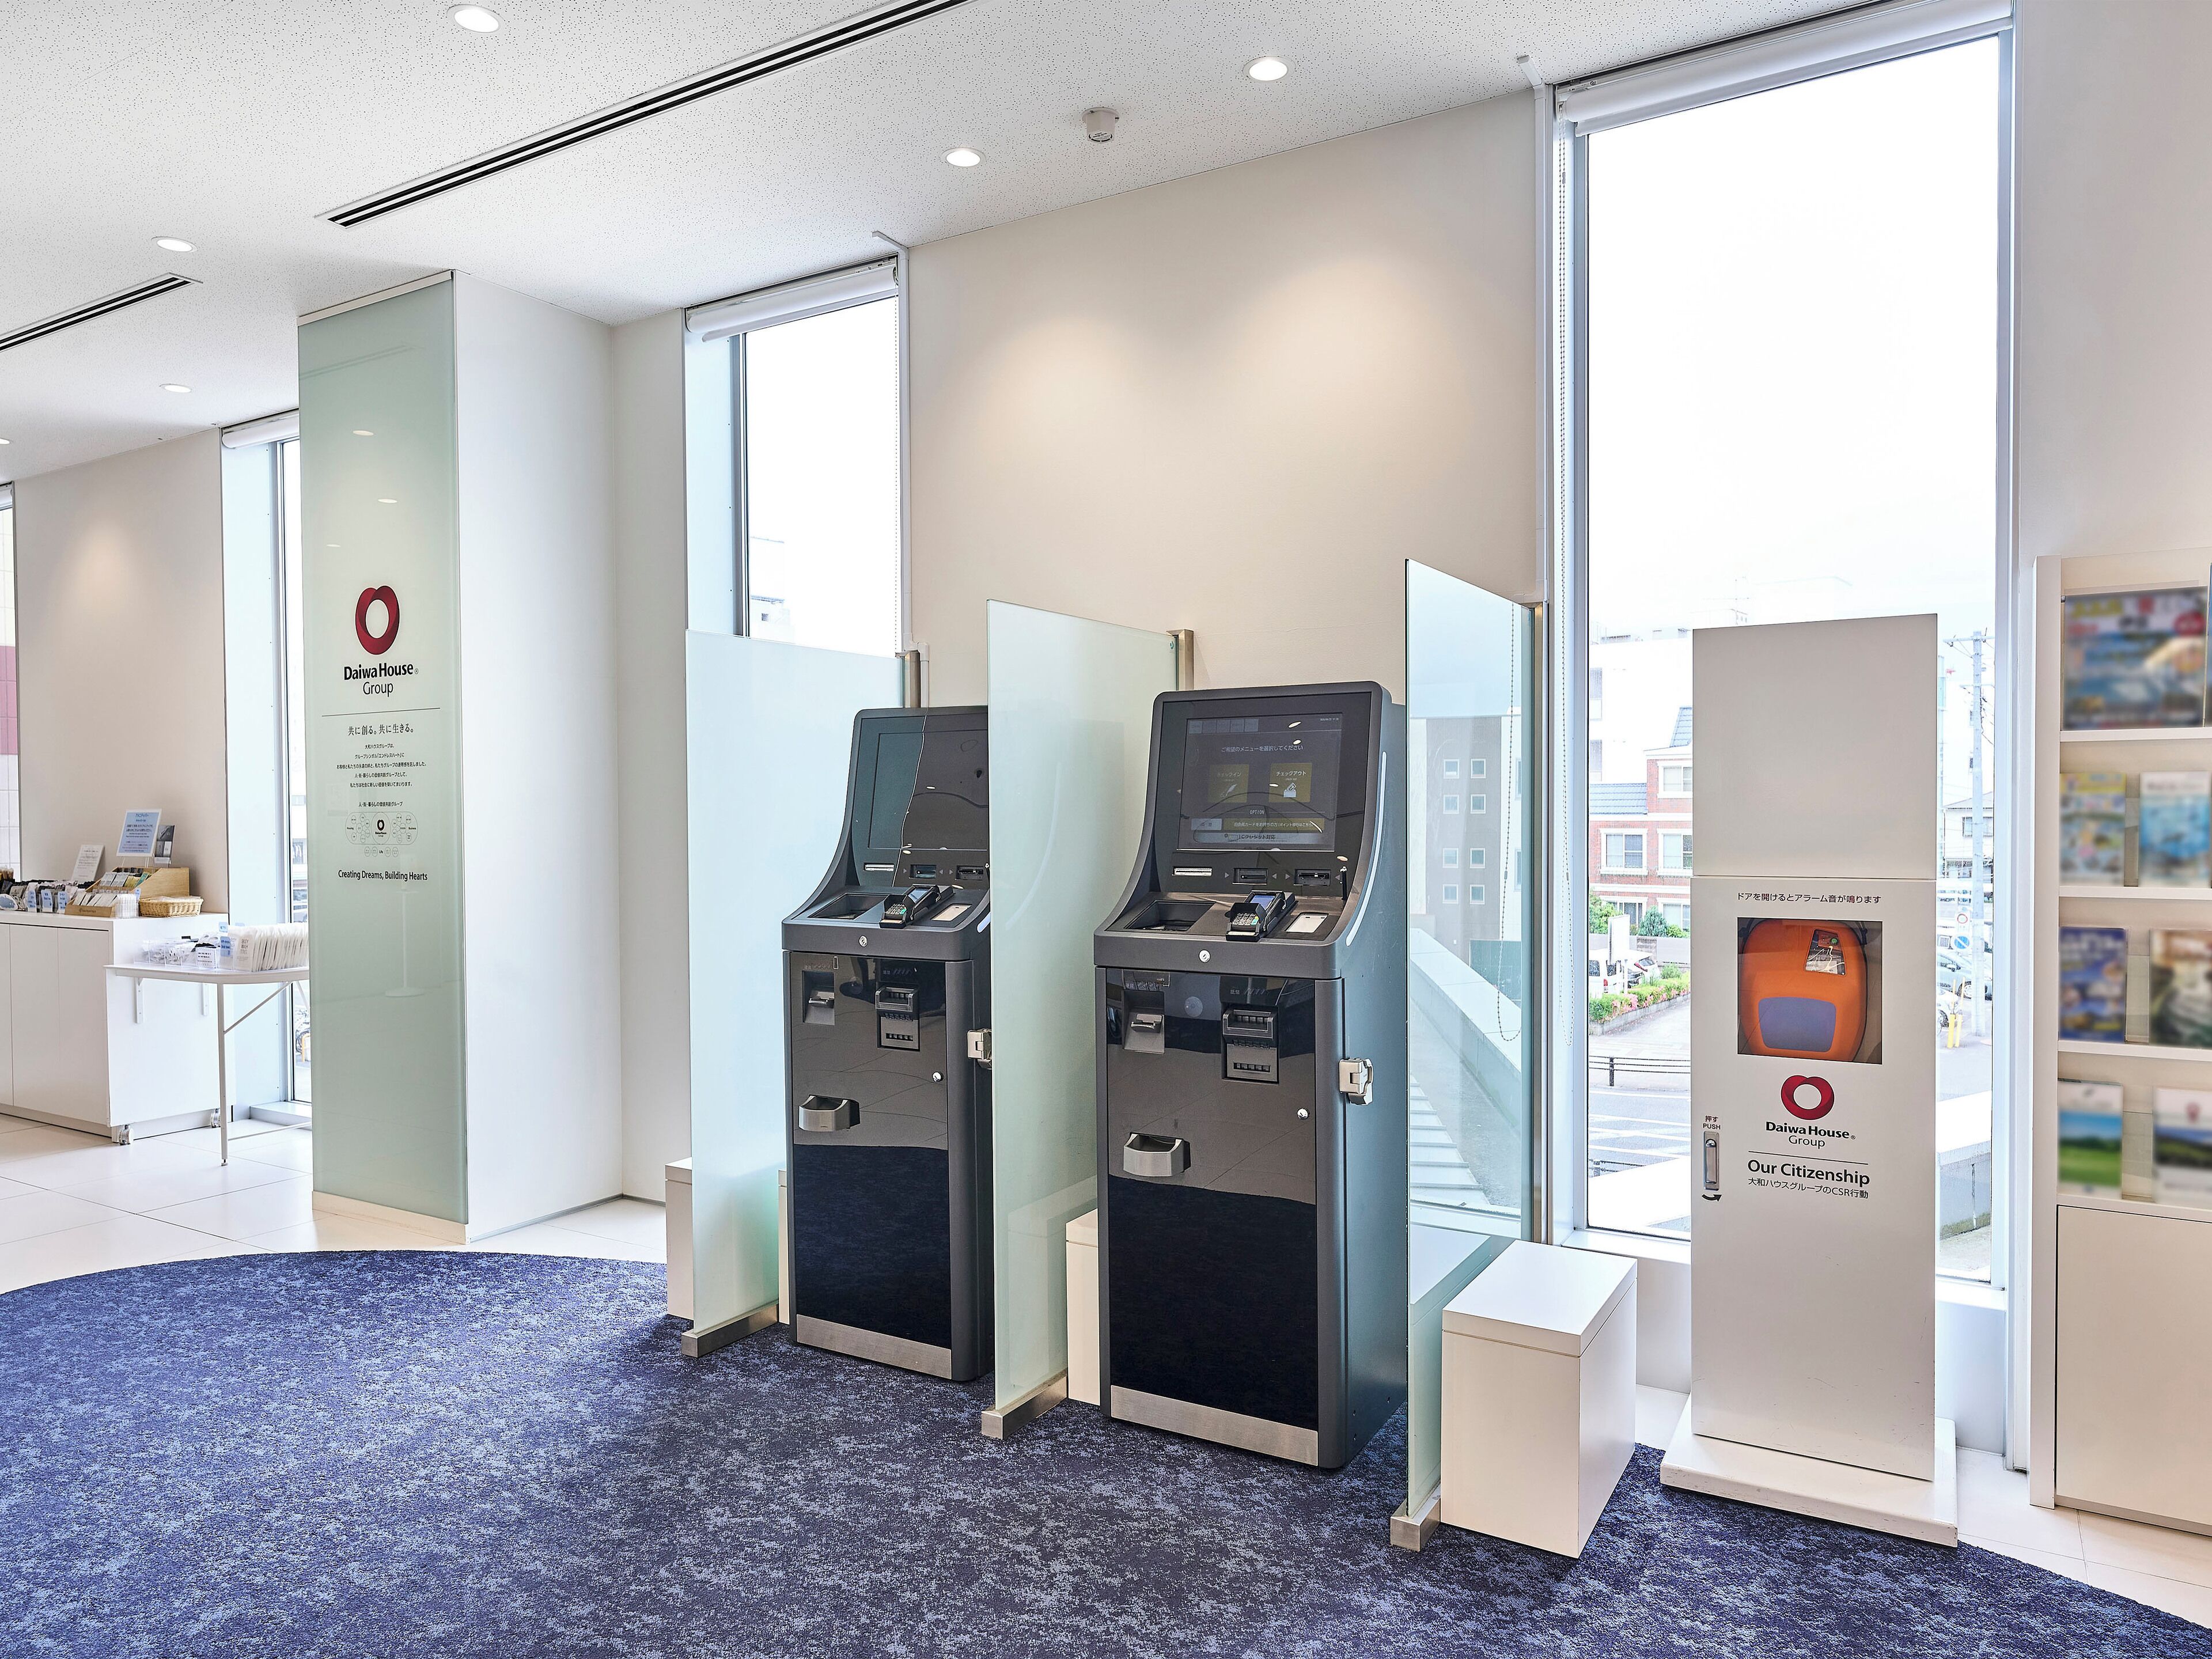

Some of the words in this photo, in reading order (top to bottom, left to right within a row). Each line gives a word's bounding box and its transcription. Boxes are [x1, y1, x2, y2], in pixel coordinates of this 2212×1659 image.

[344, 664, 377, 680] Daiwa
[379, 662, 414, 677] House
[363, 681, 393, 697] Group
[338, 870, 361, 880] Creating
[361, 870, 384, 880] Dreams,
[385, 871, 408, 882] Building
[409, 872, 427, 880] Hearts
[1737, 893, 1881, 904] ドアを開けるとアラーム音が鳴ります
[1766, 1122, 1806, 1135] Daiwa
[1808, 1126, 1850, 1139] House
[1789, 1135, 1825, 1149] Group
[1748, 1160, 1777, 1174] Our
[1781, 1163, 1870, 1187] Citizenship
[1748, 1177, 1869, 1199] 大和ハウスグループのCSR行動
